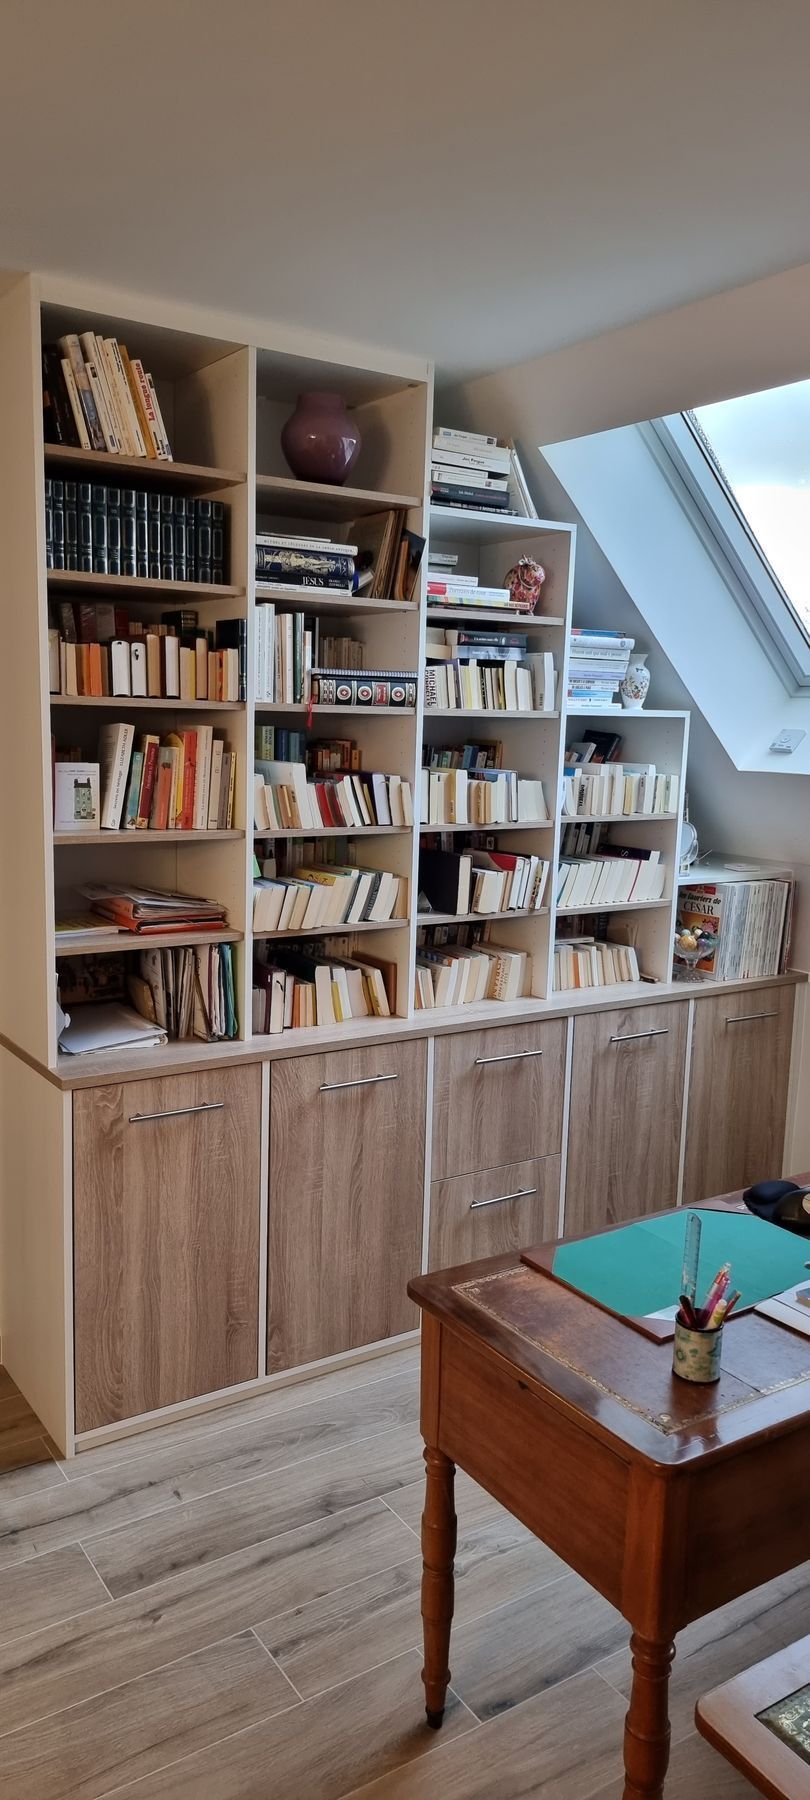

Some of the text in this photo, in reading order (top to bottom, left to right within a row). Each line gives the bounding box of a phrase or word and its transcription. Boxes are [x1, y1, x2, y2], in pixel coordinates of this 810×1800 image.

[135, 362, 146, 384] route
[141, 384, 152, 411] longue
[148, 412, 156, 421] La
[428, 669, 437, 705] MICHAEL
[687, 892, 712, 903] lauriers
[712, 897, 722, 905] de
